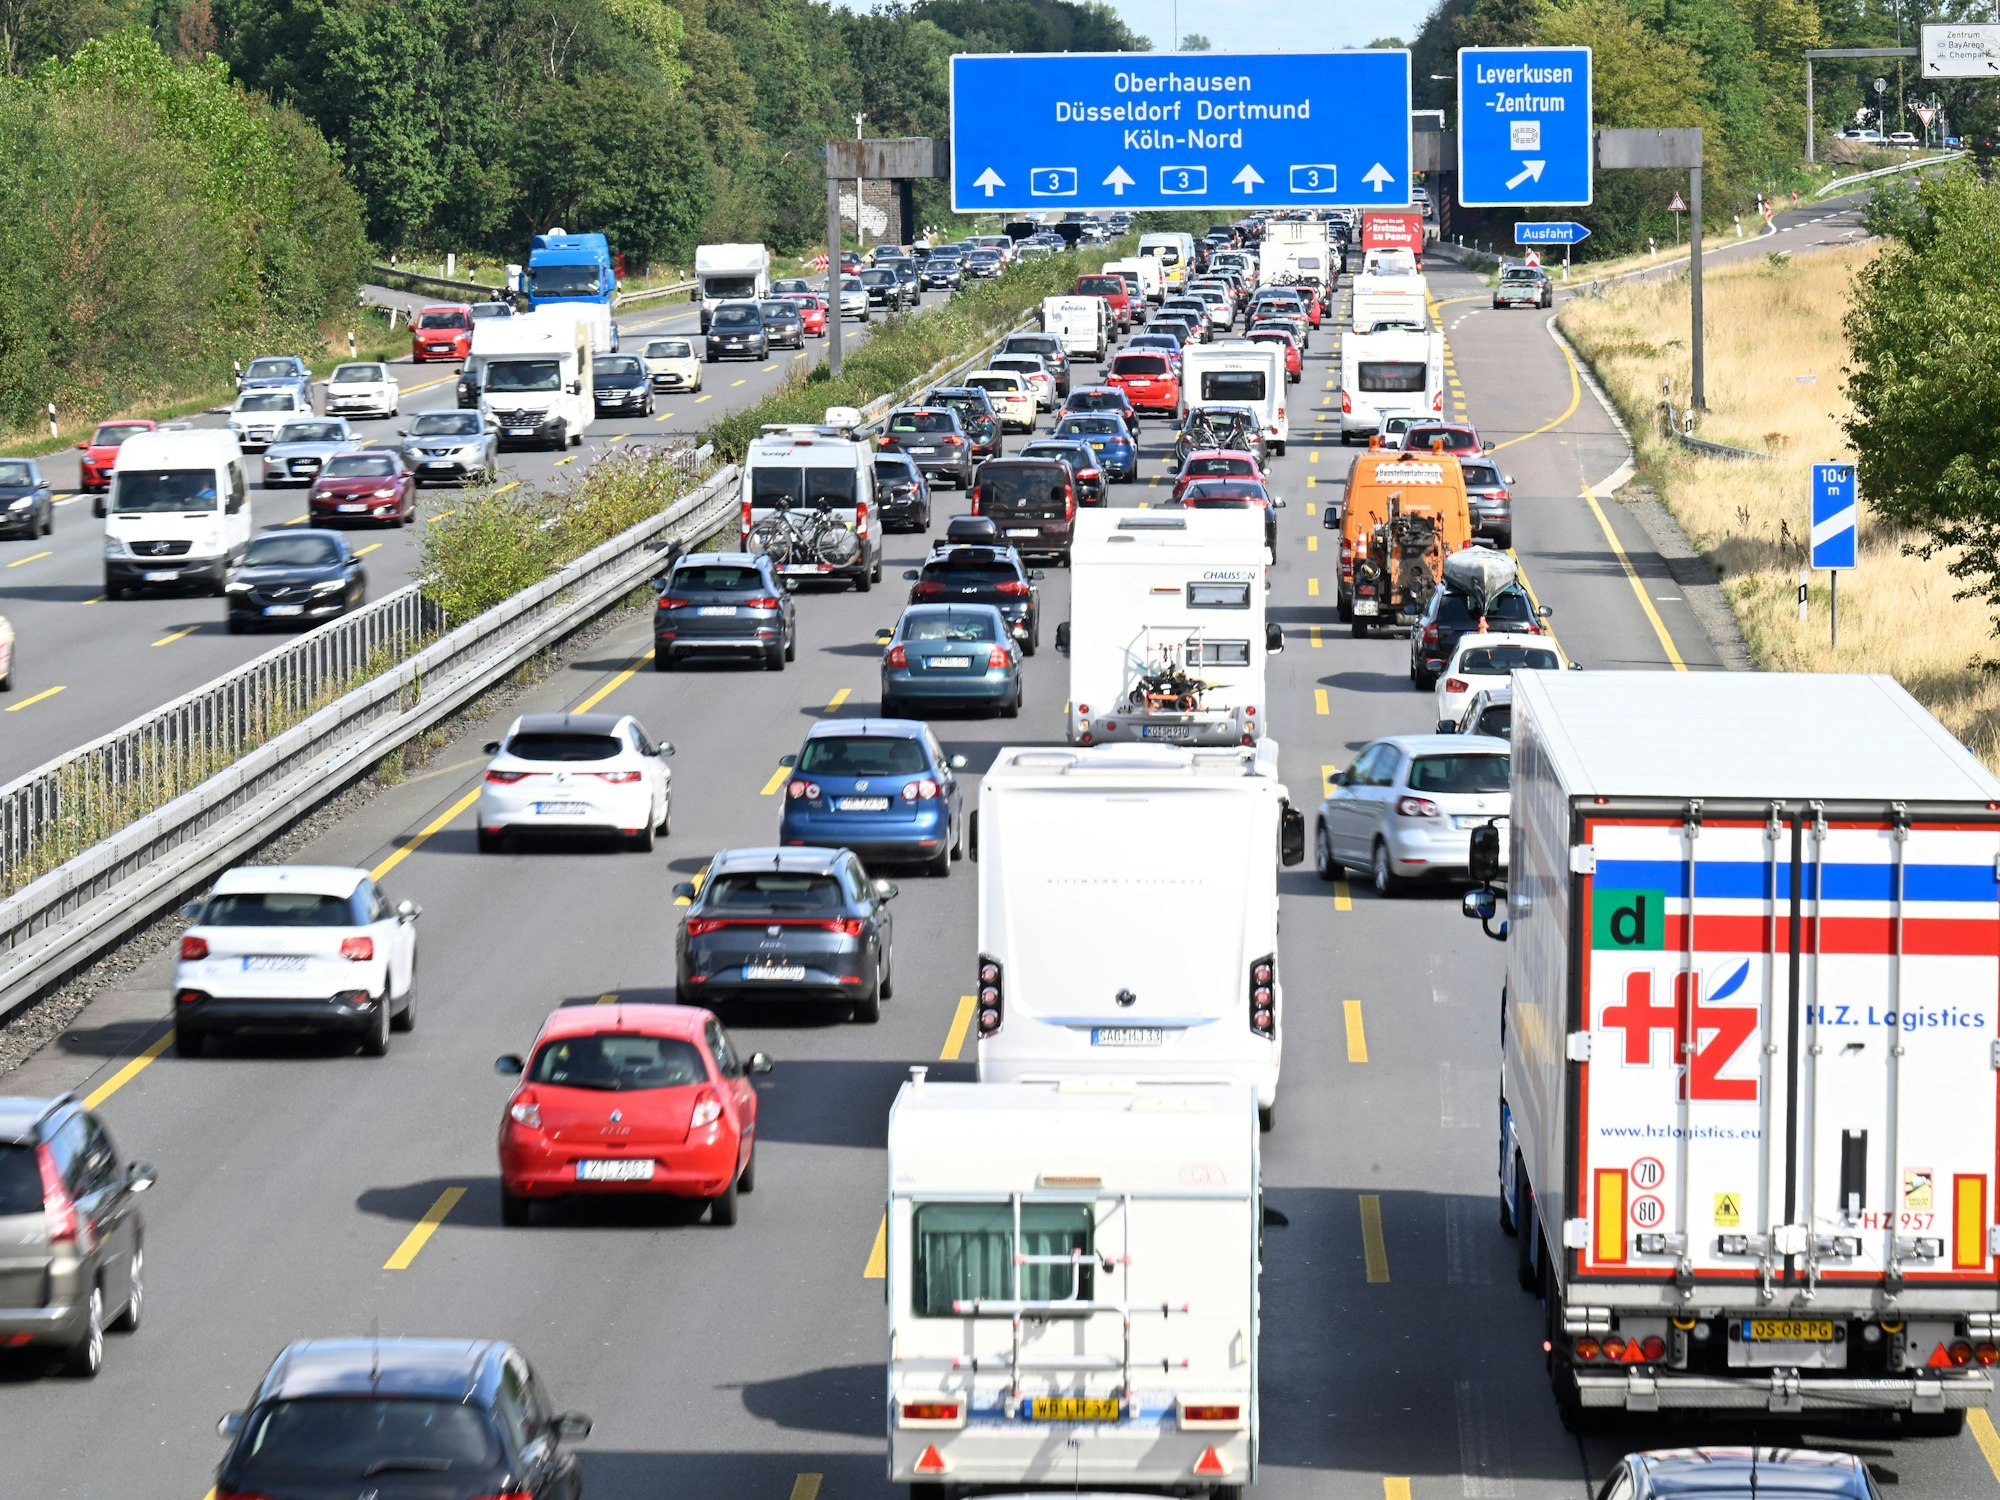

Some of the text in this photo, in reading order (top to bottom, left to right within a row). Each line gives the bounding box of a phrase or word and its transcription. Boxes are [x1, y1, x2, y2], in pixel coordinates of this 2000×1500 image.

[1947, 31, 1981, 39] Zentrum
[1948, 41, 1985, 50] BayArena
[1114, 72, 1251, 93] Oberhausen
[1477, 63, 1573, 84] Leverkusen
[1054, 99, 1311, 122] Düsseldorf Dortmund
[1485, 92, 1565, 113] -Zentrum
[1124, 128, 1242, 150] Köln-Nord
[1048, 173, 1060, 191] 3
[1178, 171, 1190, 189] 3
[1307, 170, 1319, 187] 3
[1373, 224, 1406, 232] Erstmal
[1385, 232, 1412, 242] Penny
[1523, 228, 1573, 239] Ausfahrt
[1379, 470, 1439, 479] Baustellenfahrzeug
[1827, 486, 1840, 496] m
[1203, 571, 1256, 580] CHAUSSON
[1609, 895, 1646, 945] d
[1805, 1004, 1986, 1033] H.Z. Logistics
[1601, 970, 1758, 1101] HZ
[1599, 1124, 1761, 1141] www.hzlogistics.eu
[1639, 1163, 1656, 1183] 70
[1639, 1201, 1656, 1222] 80
[1863, 1212, 1935, 1230] HZ 957
[1755, 1322, 1829, 1337] OS-08-PG
